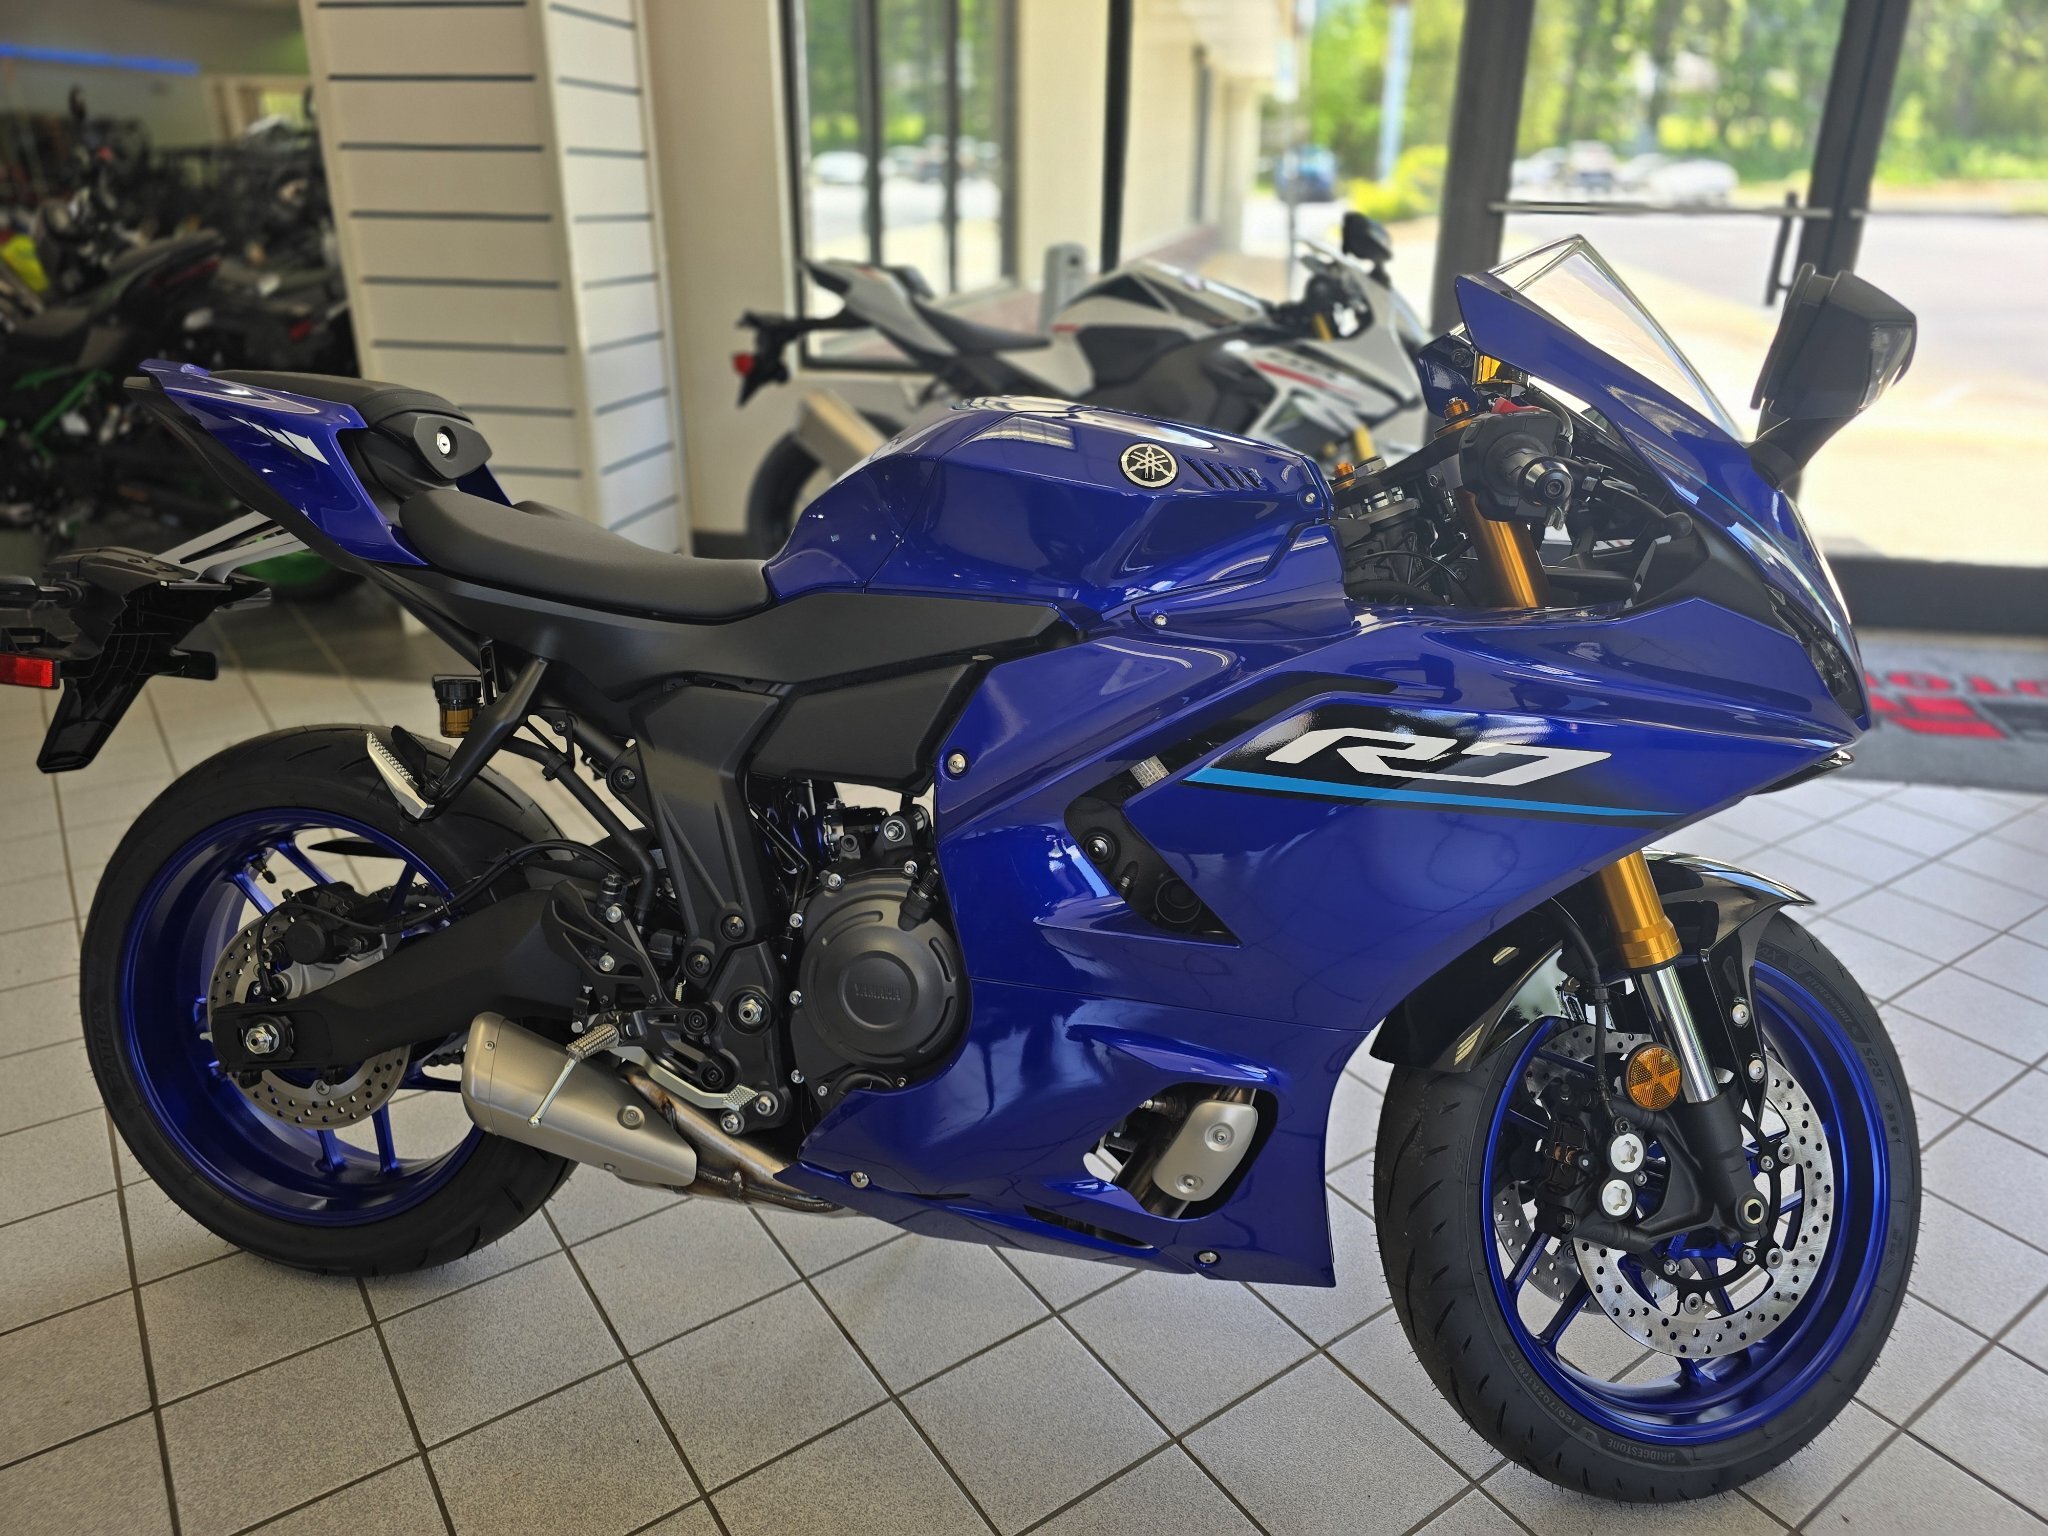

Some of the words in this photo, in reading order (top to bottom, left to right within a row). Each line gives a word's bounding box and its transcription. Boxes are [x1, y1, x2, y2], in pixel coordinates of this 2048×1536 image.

[1265, 727, 1612, 786] R7
[853, 983, 902, 1001] YAMAHA
[1606, 1437, 1677, 1465] BRIDGESTONE
